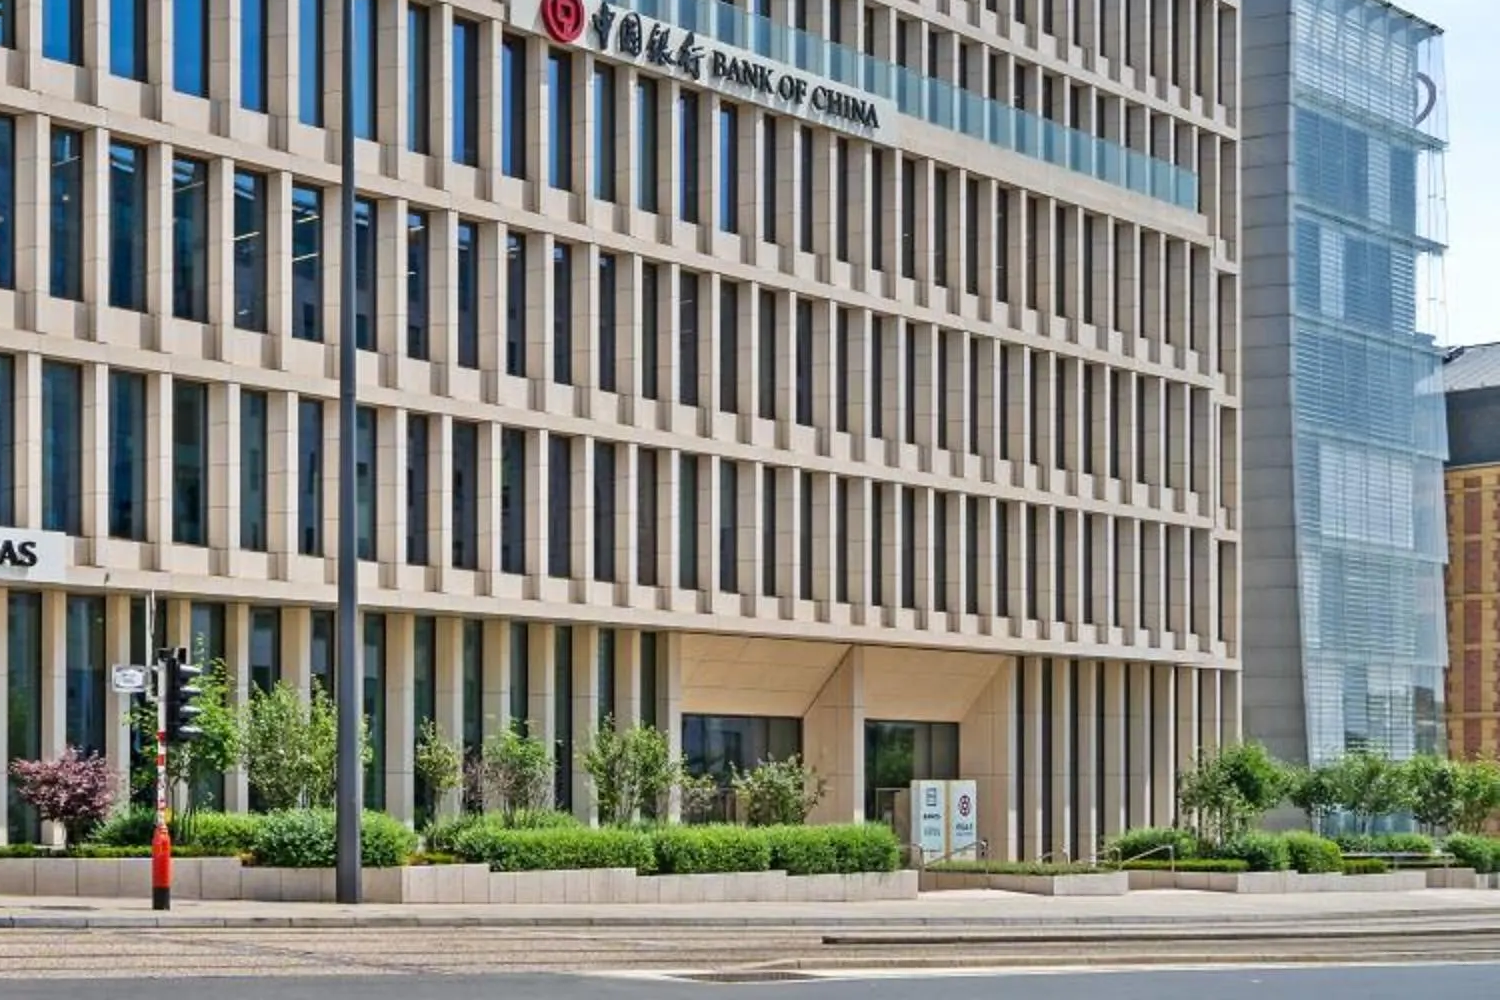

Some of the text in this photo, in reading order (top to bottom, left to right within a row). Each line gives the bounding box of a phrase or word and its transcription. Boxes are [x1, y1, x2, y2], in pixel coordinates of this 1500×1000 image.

[713, 50, 774, 94] BANK
[778, 75, 807, 105] OF
[811, 85, 879, 128] CHINA
